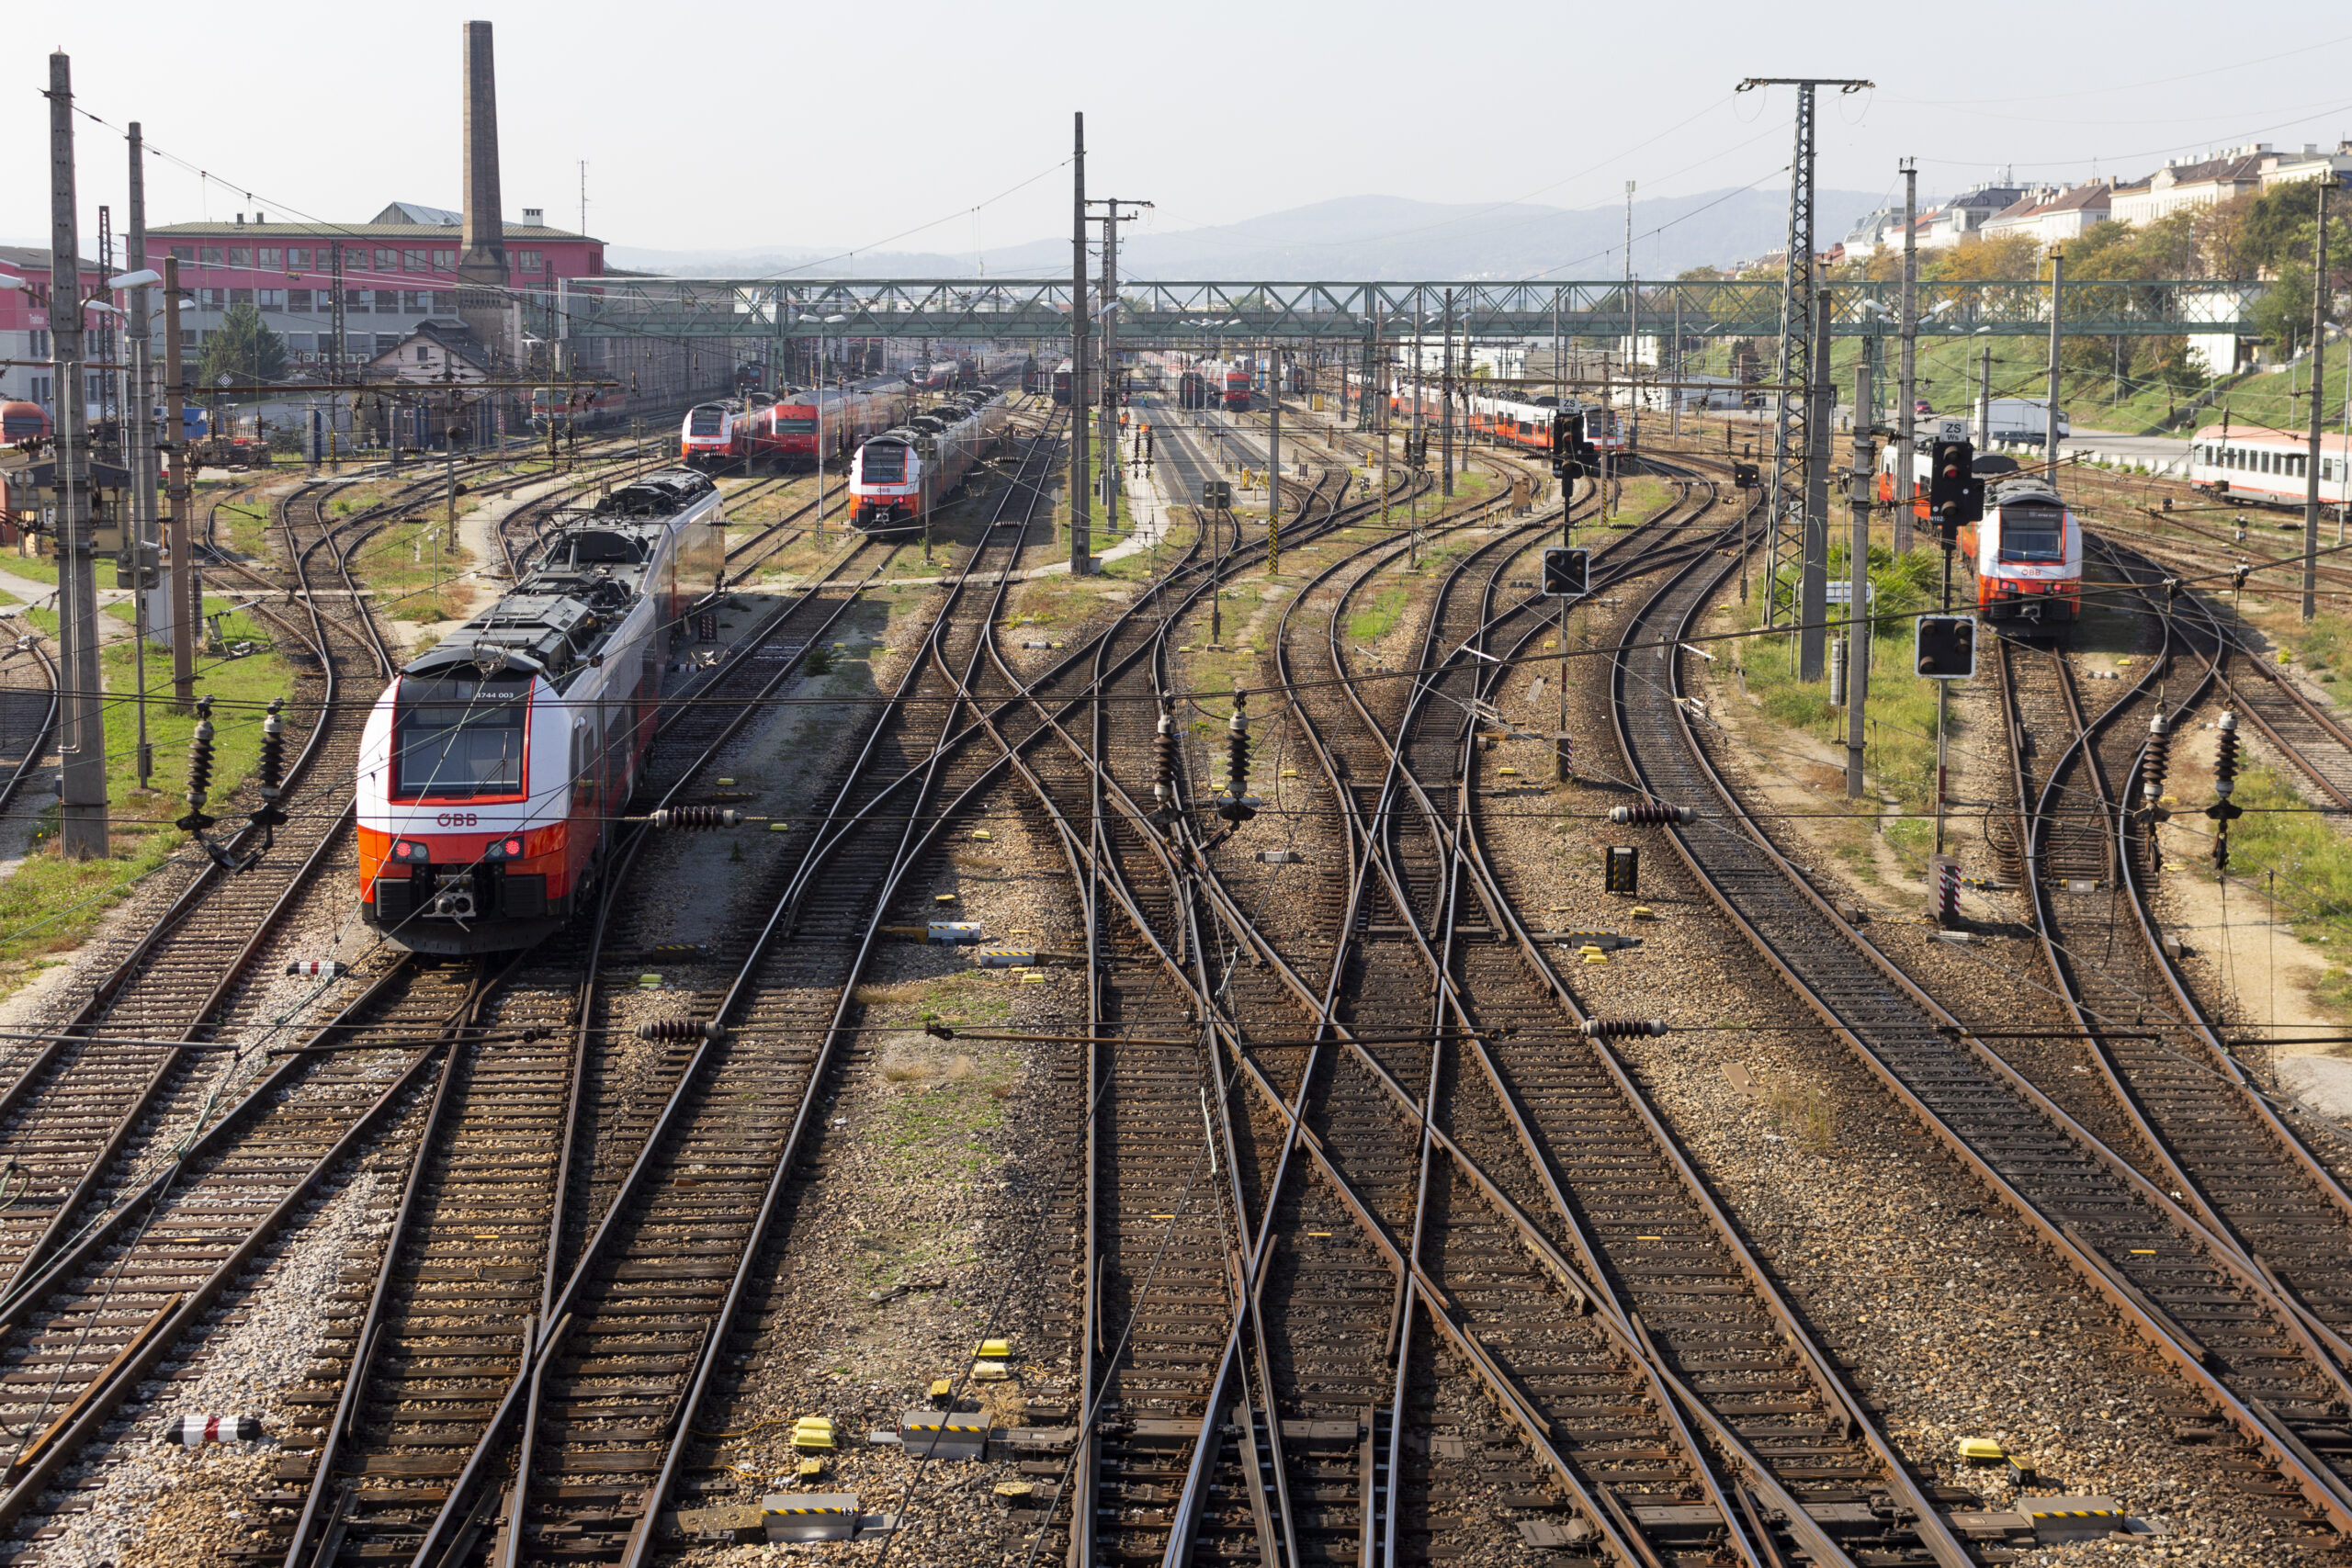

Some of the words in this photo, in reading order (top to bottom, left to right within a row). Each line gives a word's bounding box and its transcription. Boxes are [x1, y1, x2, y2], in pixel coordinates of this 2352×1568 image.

[1946, 423, 1962, 434] ZS
[46, 508, 52, 523] F
[436, 812, 478, 827] ÖBB
[841, 1506, 854, 1517] 13
